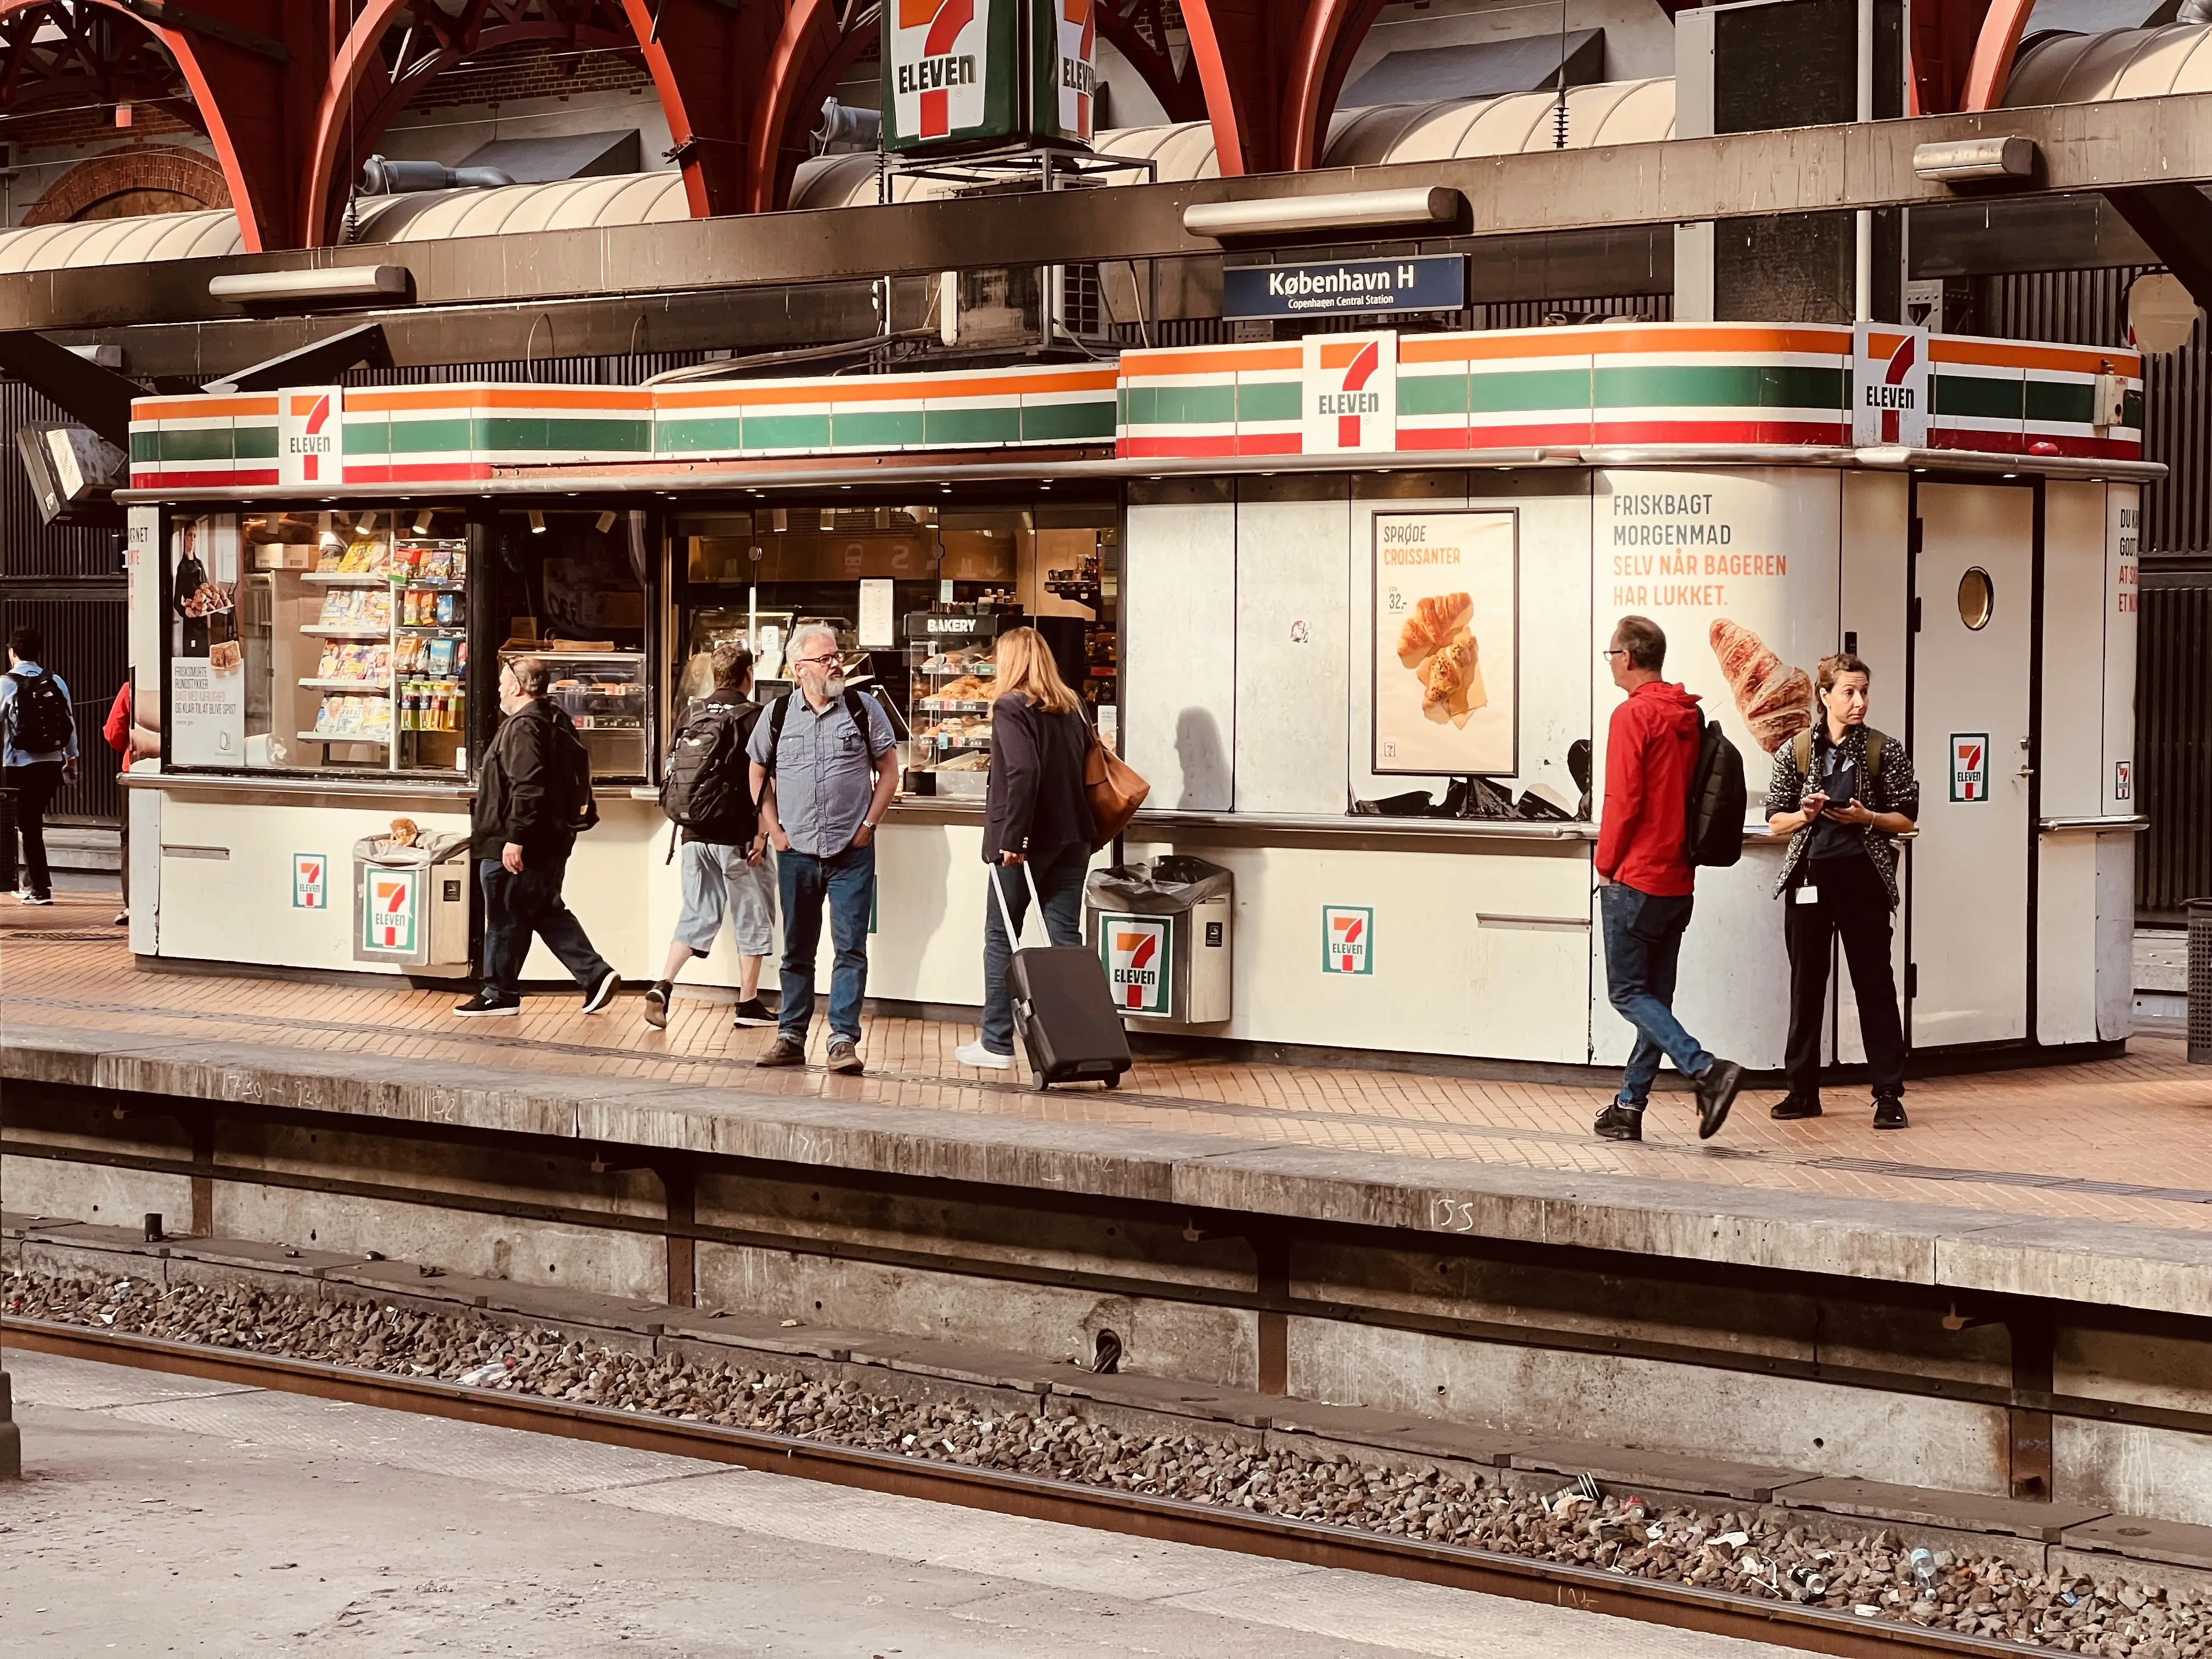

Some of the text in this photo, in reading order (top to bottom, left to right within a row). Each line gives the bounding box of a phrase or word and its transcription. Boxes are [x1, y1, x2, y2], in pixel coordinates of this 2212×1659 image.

[1269, 265, 1414, 296] København H
[1288, 295, 1393, 310] Copenhagen Central Station
[1613, 494, 1713, 515] FRISKBAGT
[2121, 509, 2131, 528] DU
[1384, 523, 1426, 545] SPRØDE
[1613, 524, 1730, 546] MORGENMAD
[1384, 548, 1460, 565] CROISSANTER
[1613, 548, 1786, 575] SELV NÅR BAGEREN
[2119, 566, 2129, 584] AT
[1613, 585, 1728, 606] HAR LUKKET.
[2119, 594, 2128, 612] ET
[927, 619, 976, 633] BAKERY
